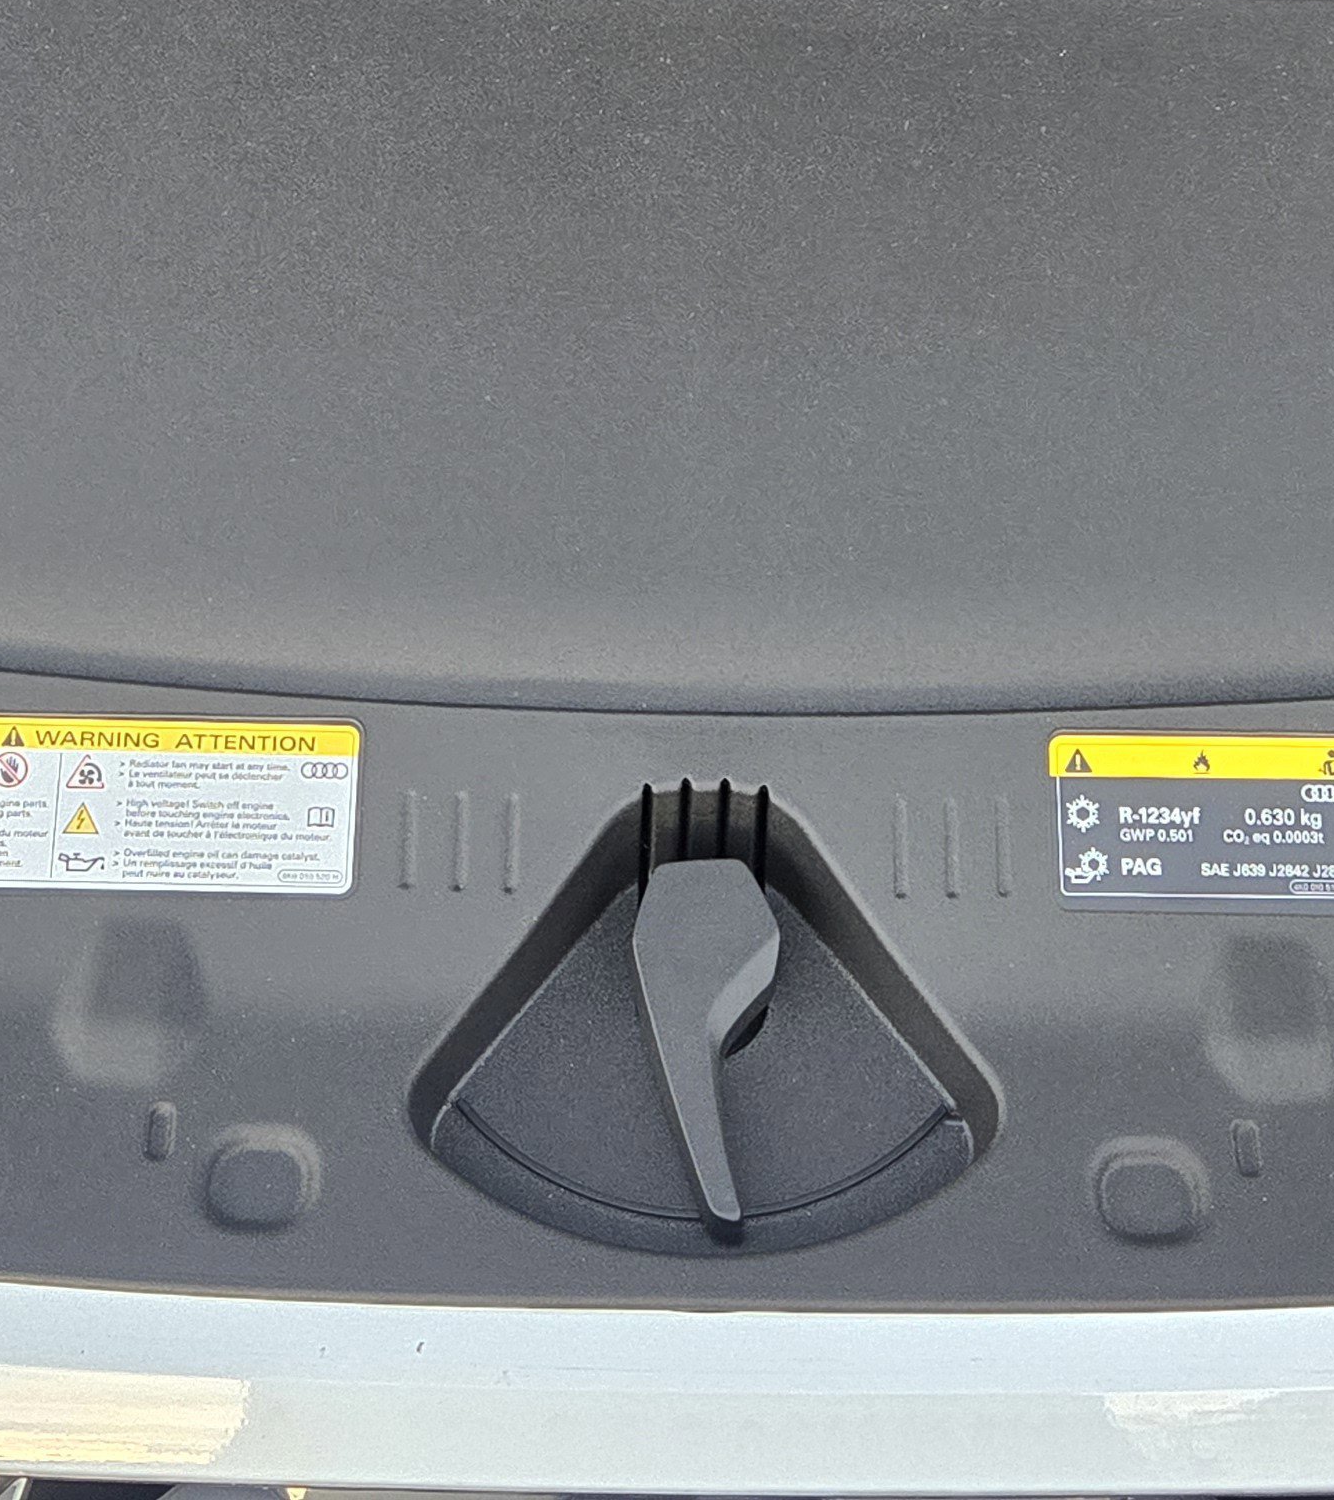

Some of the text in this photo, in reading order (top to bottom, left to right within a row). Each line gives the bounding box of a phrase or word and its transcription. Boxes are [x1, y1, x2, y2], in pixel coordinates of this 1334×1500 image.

[36, 731, 316, 752] WARNING ATTENTION
[130, 760, 168, 768] Radiator
[189, 762, 209, 770] may
[212, 762, 232, 770] start
[247, 763, 263, 772] any
[129, 770, 139, 778] Le
[195, 772, 216, 780] peut
[126, 800, 148, 809] High
[192, 801, 224, 809] Switch
[242, 803, 273, 811] engine
[126, 809, 156, 817] before
[159, 811, 200, 819] touching
[203, 812, 234, 820] engine
[1119, 807, 1201, 828] R-1234yf
[1244, 808, 1322, 829] 0.630 kg
[0, 829, 10, 837] du
[124, 830, 149, 838] avant
[281, 832, 293, 840] du
[1120, 828, 1193, 842] GWP 0.501
[1253, 833, 1270, 845] eq
[1273, 831, 1325, 844] 0.0003t
[124, 849, 169, 858] Overfilled
[172, 850, 204, 860] engine
[207, 850, 219, 858] oil
[241, 851, 279, 861] damage
[1121, 858, 1162, 875] PAG
[1201, 863, 1229, 876] SAE
[1233, 864, 1265, 876] J639
[1269, 864, 1310, 877] J2842
[122, 870, 143, 878] peut
